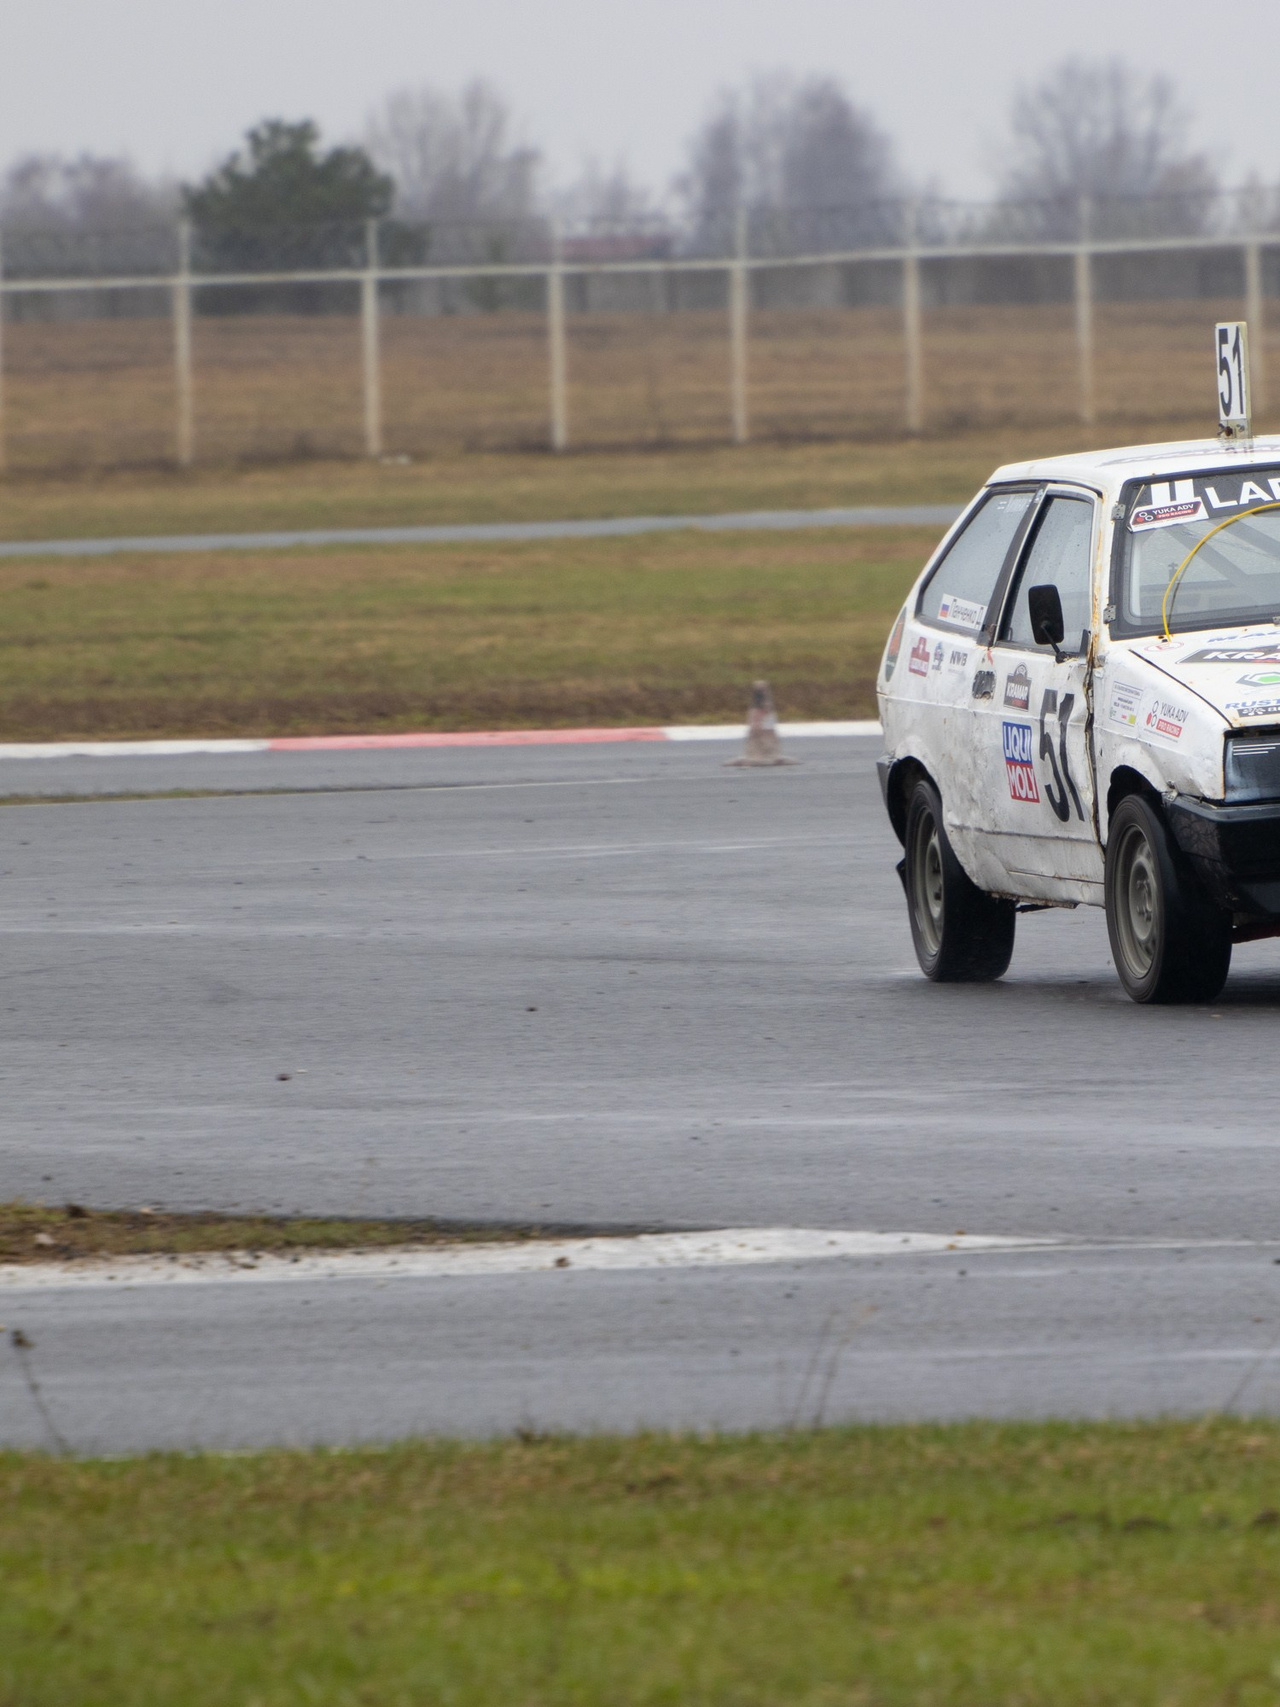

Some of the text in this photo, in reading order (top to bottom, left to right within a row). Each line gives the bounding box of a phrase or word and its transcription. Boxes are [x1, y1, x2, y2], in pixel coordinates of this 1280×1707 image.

[1218, 325, 1244, 417] 51
[1152, 503, 1194, 515] YUKA ADV
[949, 650, 968, 667] NWB
[1006, 682, 1029, 701] KRAMAR
[1160, 701, 1190, 724] YUKA ADV
[1157, 720, 1168, 732] PRO
[1166, 723, 1182, 737] RACING
[1003, 725, 1032, 761] LIQUI
[1039, 688, 1085, 823] 51
[1007, 764, 1038, 800] MOLY
